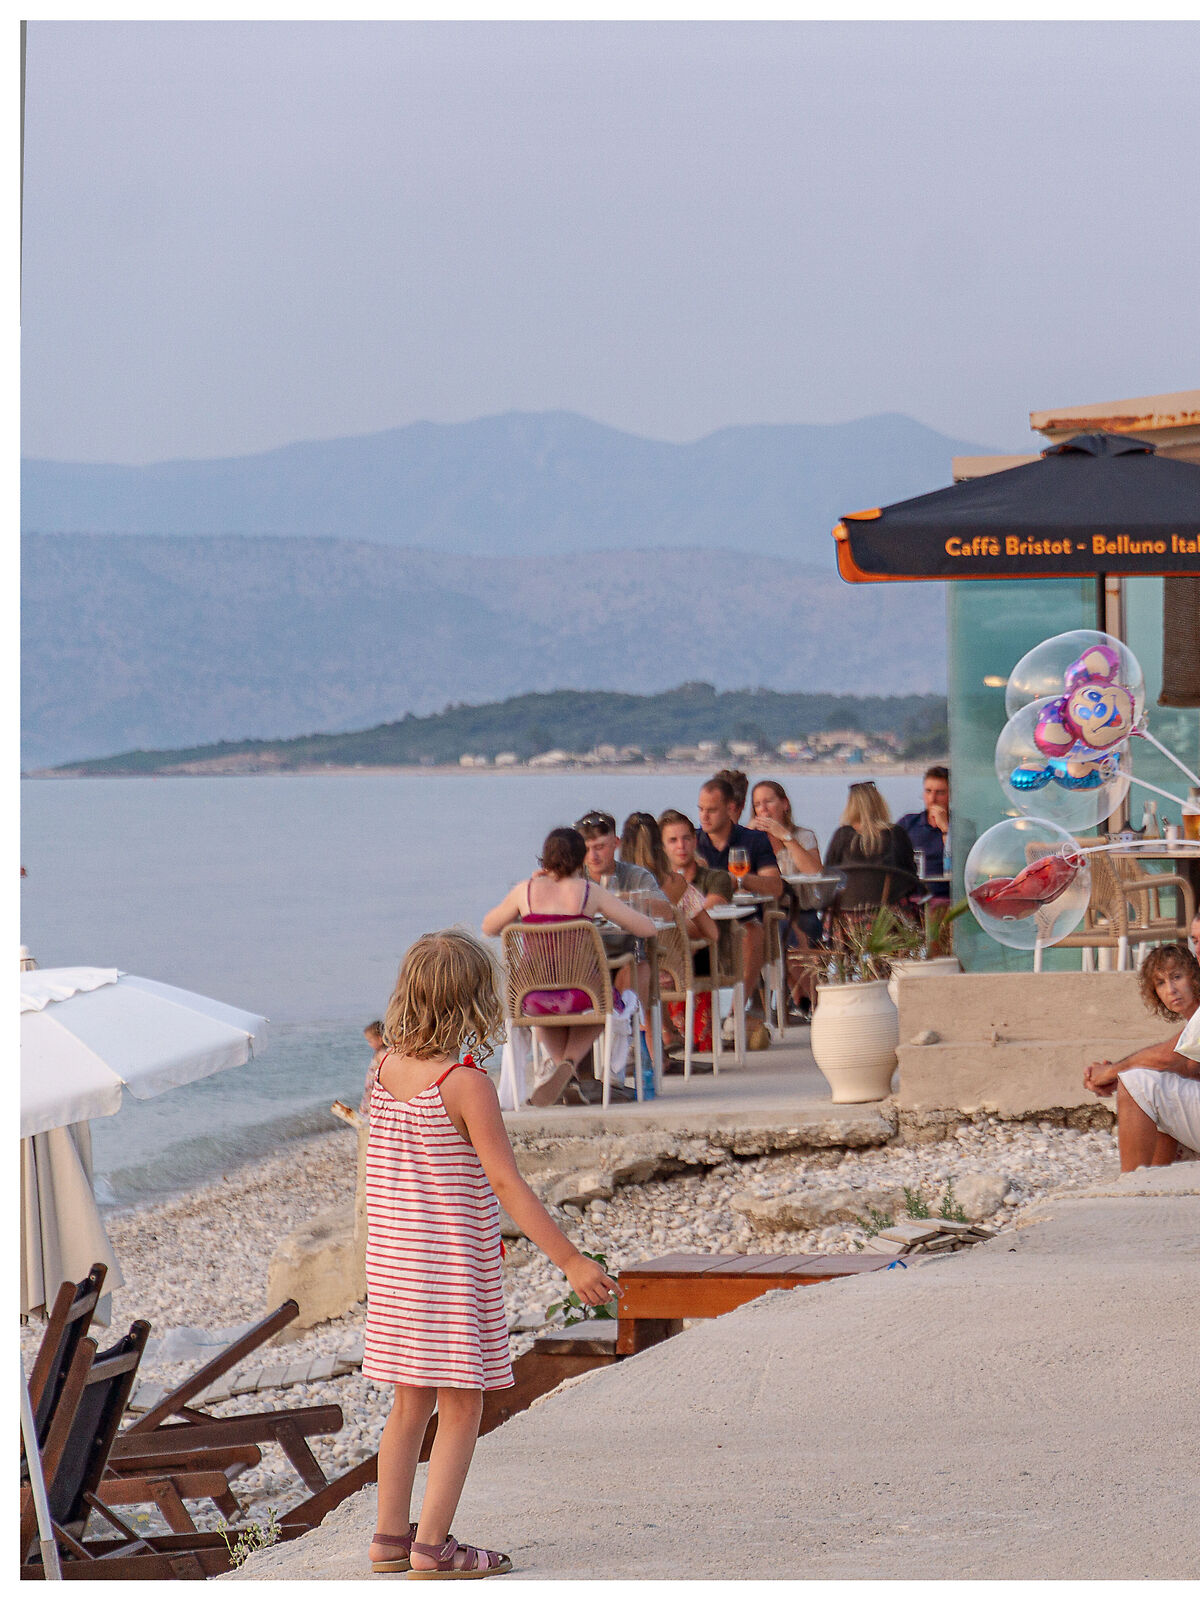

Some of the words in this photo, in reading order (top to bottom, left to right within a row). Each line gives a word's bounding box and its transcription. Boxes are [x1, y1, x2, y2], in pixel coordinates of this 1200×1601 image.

[945, 535, 1000, 556] Caffè
[1005, 534, 1073, 555] Bristot
[1092, 533, 1167, 555] Belluno
